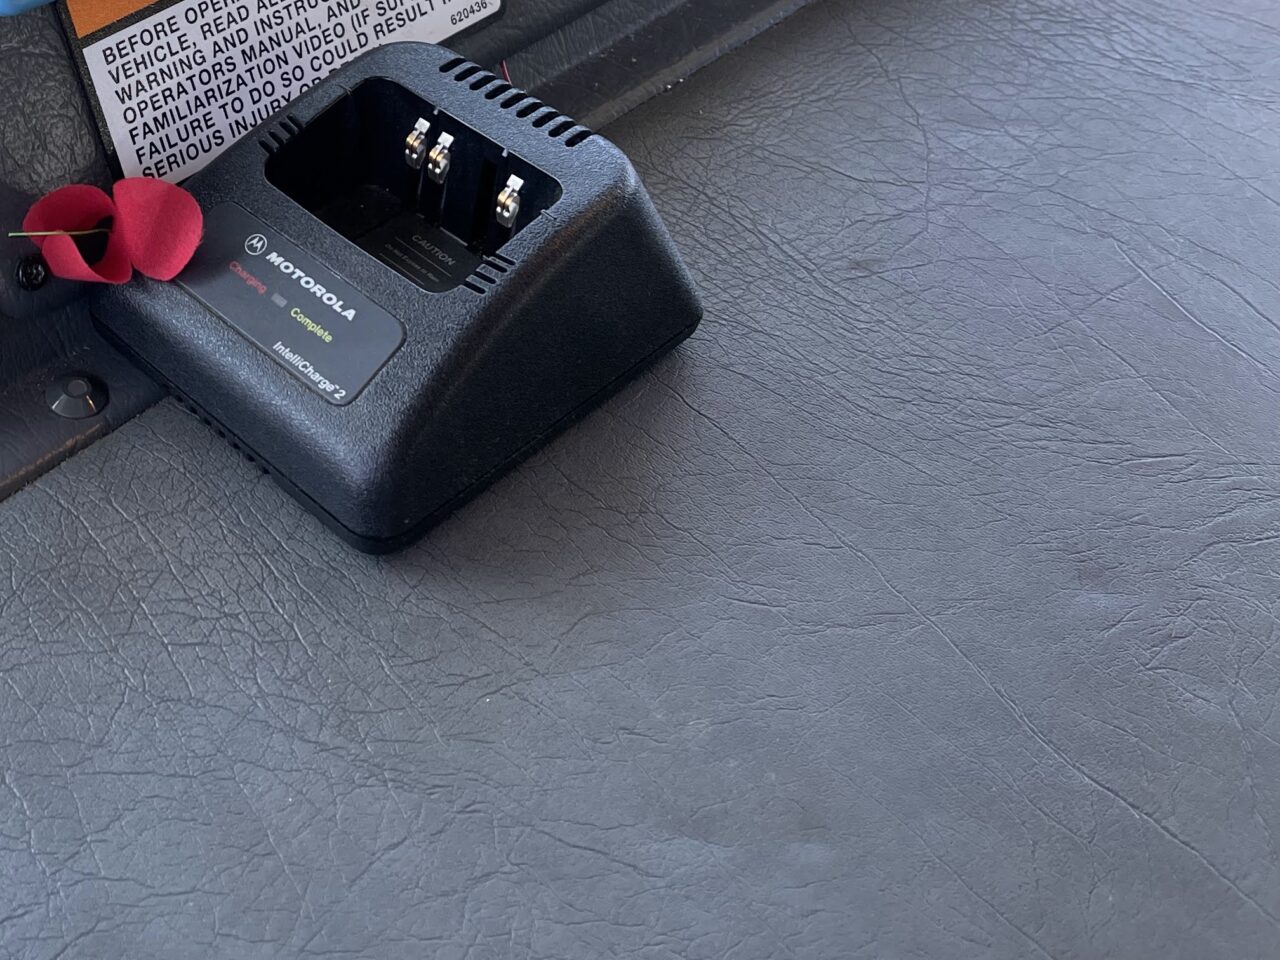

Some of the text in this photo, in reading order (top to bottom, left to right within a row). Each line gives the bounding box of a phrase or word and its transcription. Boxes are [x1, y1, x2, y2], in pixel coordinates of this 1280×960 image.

[102, 15, 180, 65] BEFORE
[107, 33, 196, 84] VEHICLE,
[200, 5, 249, 40] READ
[114, 49, 206, 104] WARNING
[213, 28, 248, 58] AND
[123, 55, 236, 124] OPERATORS
[241, 17, 321, 65] MANUAL,
[128, 50, 288, 145] FAMILIARIZATION
[291, 22, 345, 58] VIDEO
[351, 7, 376, 36] (IF
[135, 111, 215, 165] FAILURE
[220, 96, 243, 119] TO
[248, 80, 275, 105] DO
[280, 65, 304, 88] SO
[310, 32, 368, 72] COULD
[142, 129, 225, 179] SERIOUS
[229, 260, 268, 295] Charging
[412, 235, 456, 266] CAUTION
[266, 251, 357, 322] MOTOROLA
[290, 307, 333, 343] Complete
[335, 388, 347, 401] 2
